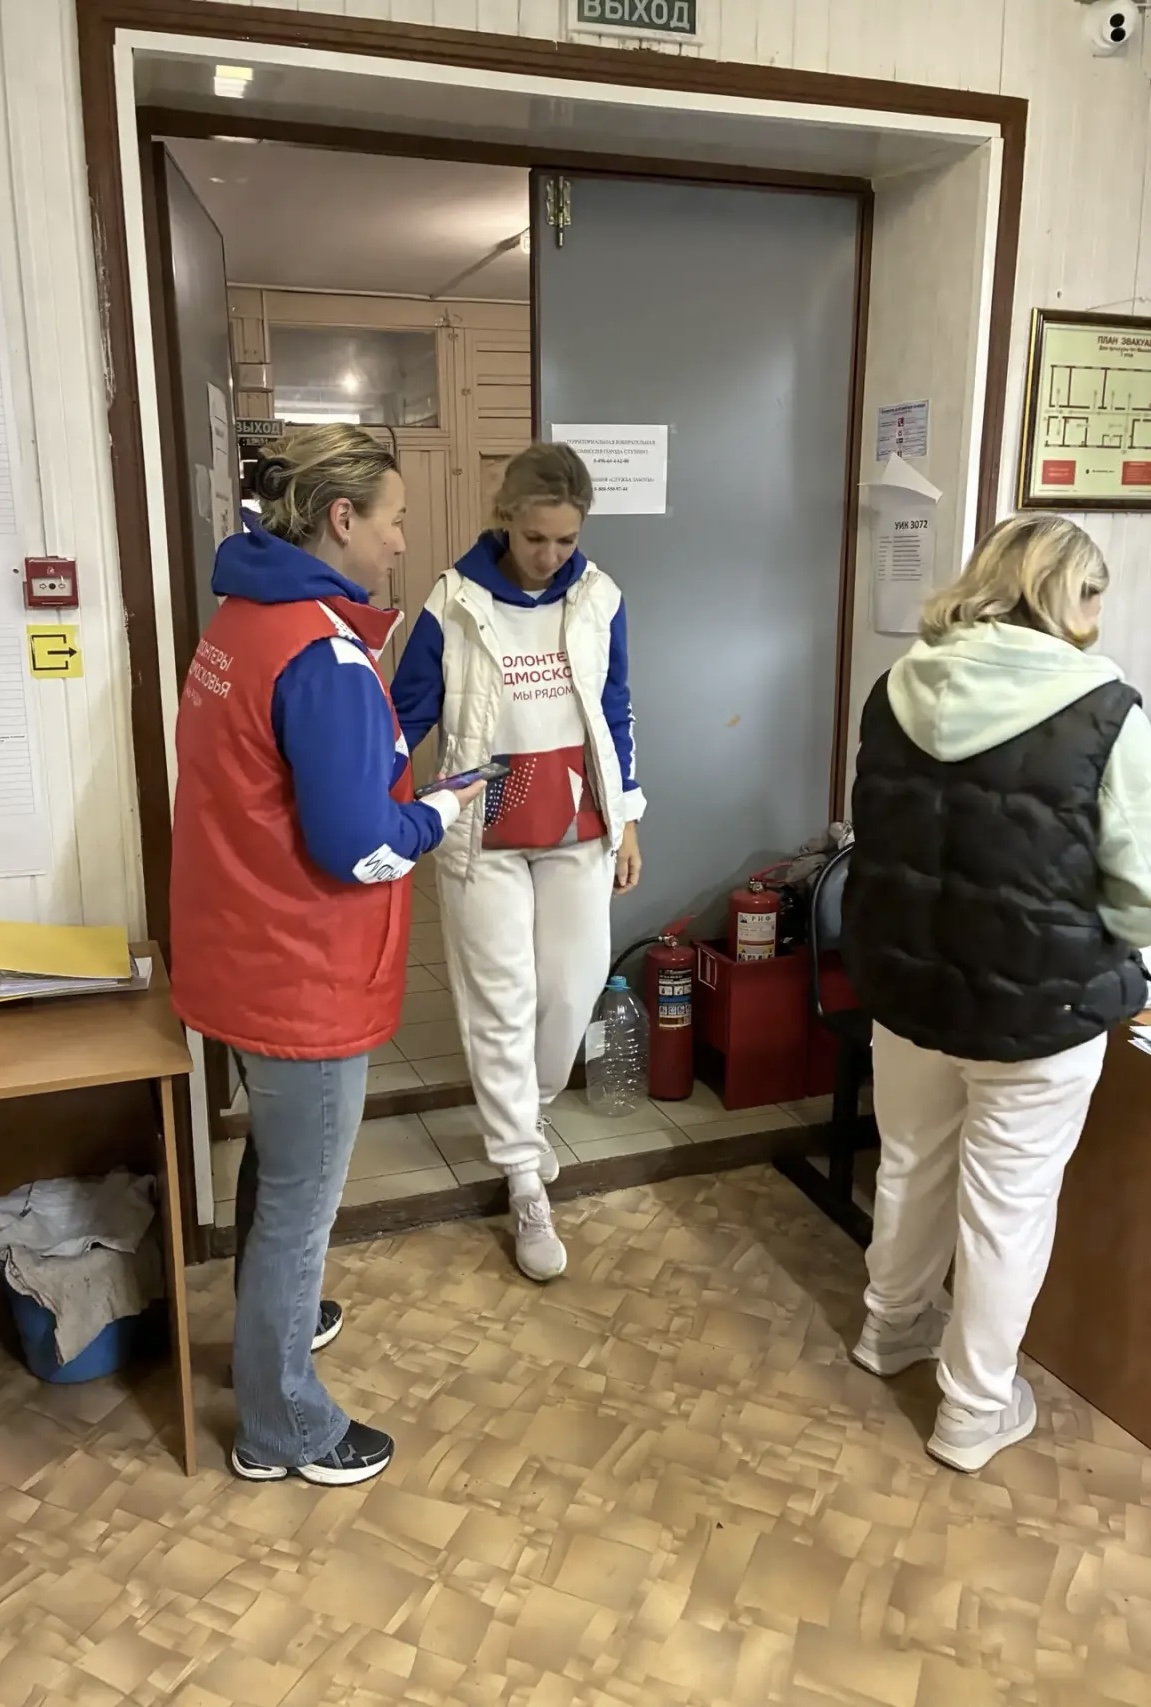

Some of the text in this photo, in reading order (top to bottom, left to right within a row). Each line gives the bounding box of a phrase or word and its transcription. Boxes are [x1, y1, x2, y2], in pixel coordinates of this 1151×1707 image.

[583, 0, 690, 30] ВЫХОД
[1097, 335, 1118, 345] ПЛАН
[894, 520, 928, 530] УИК 3072
[502, 652, 568, 667] ОЛОНТЕ
[504, 666, 572, 685] ДМОСКО
[512, 686, 575, 701] МЫ РЯДОМ
